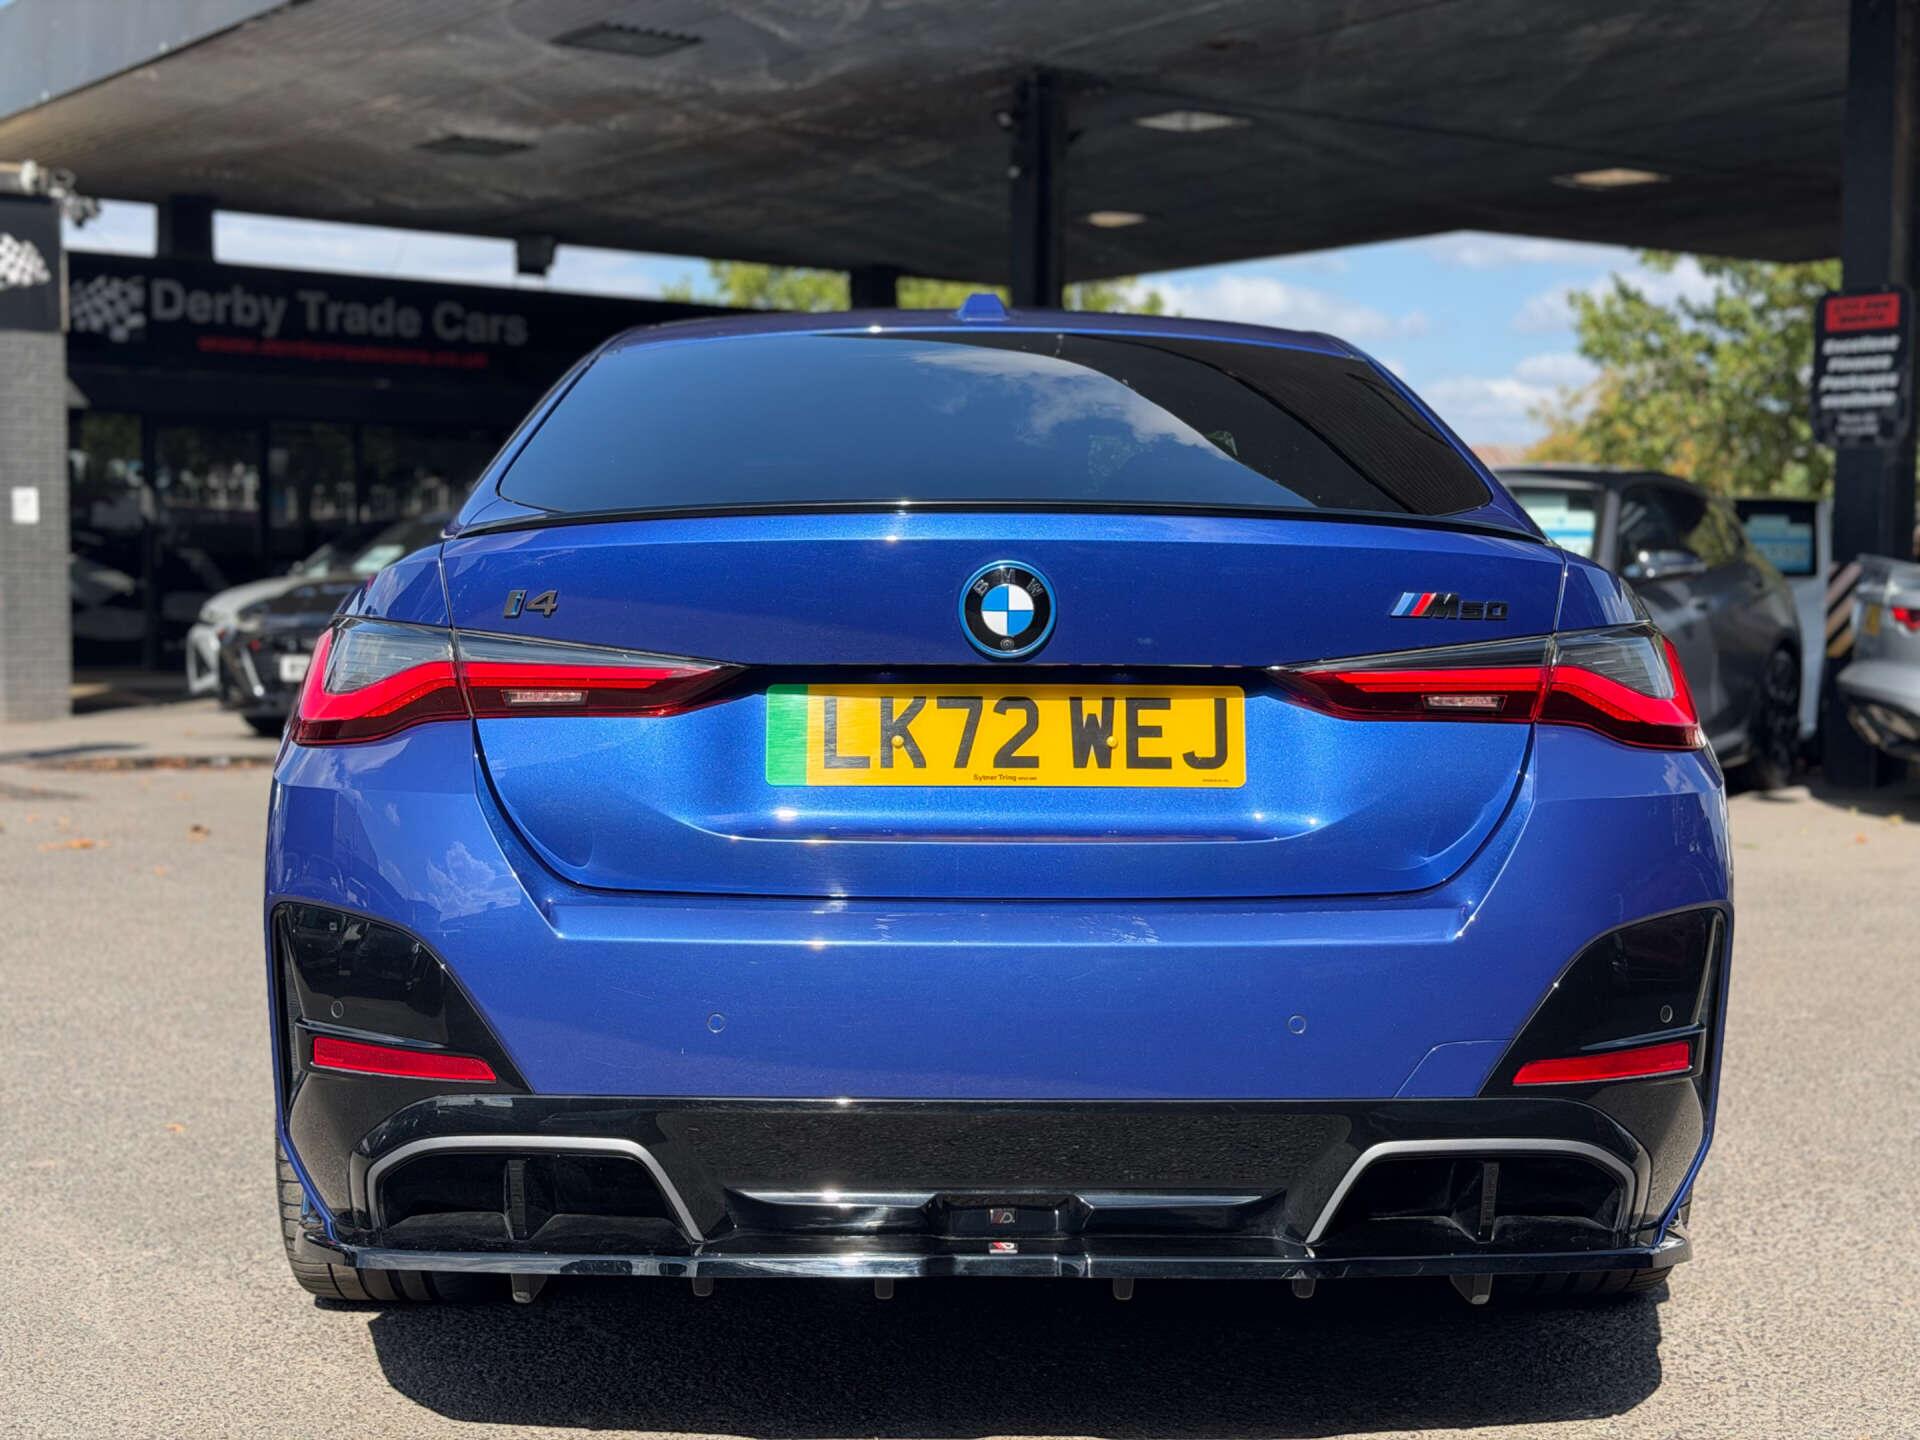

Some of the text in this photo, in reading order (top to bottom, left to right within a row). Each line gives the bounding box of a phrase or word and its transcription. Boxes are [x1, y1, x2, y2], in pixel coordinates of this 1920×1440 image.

[151, 278, 527, 346] Derby Trade Cars
[973, 568, 1043, 597] BMW
[1421, 592, 1507, 619] M50
[823, 696, 1228, 769] LK72 WEJ
